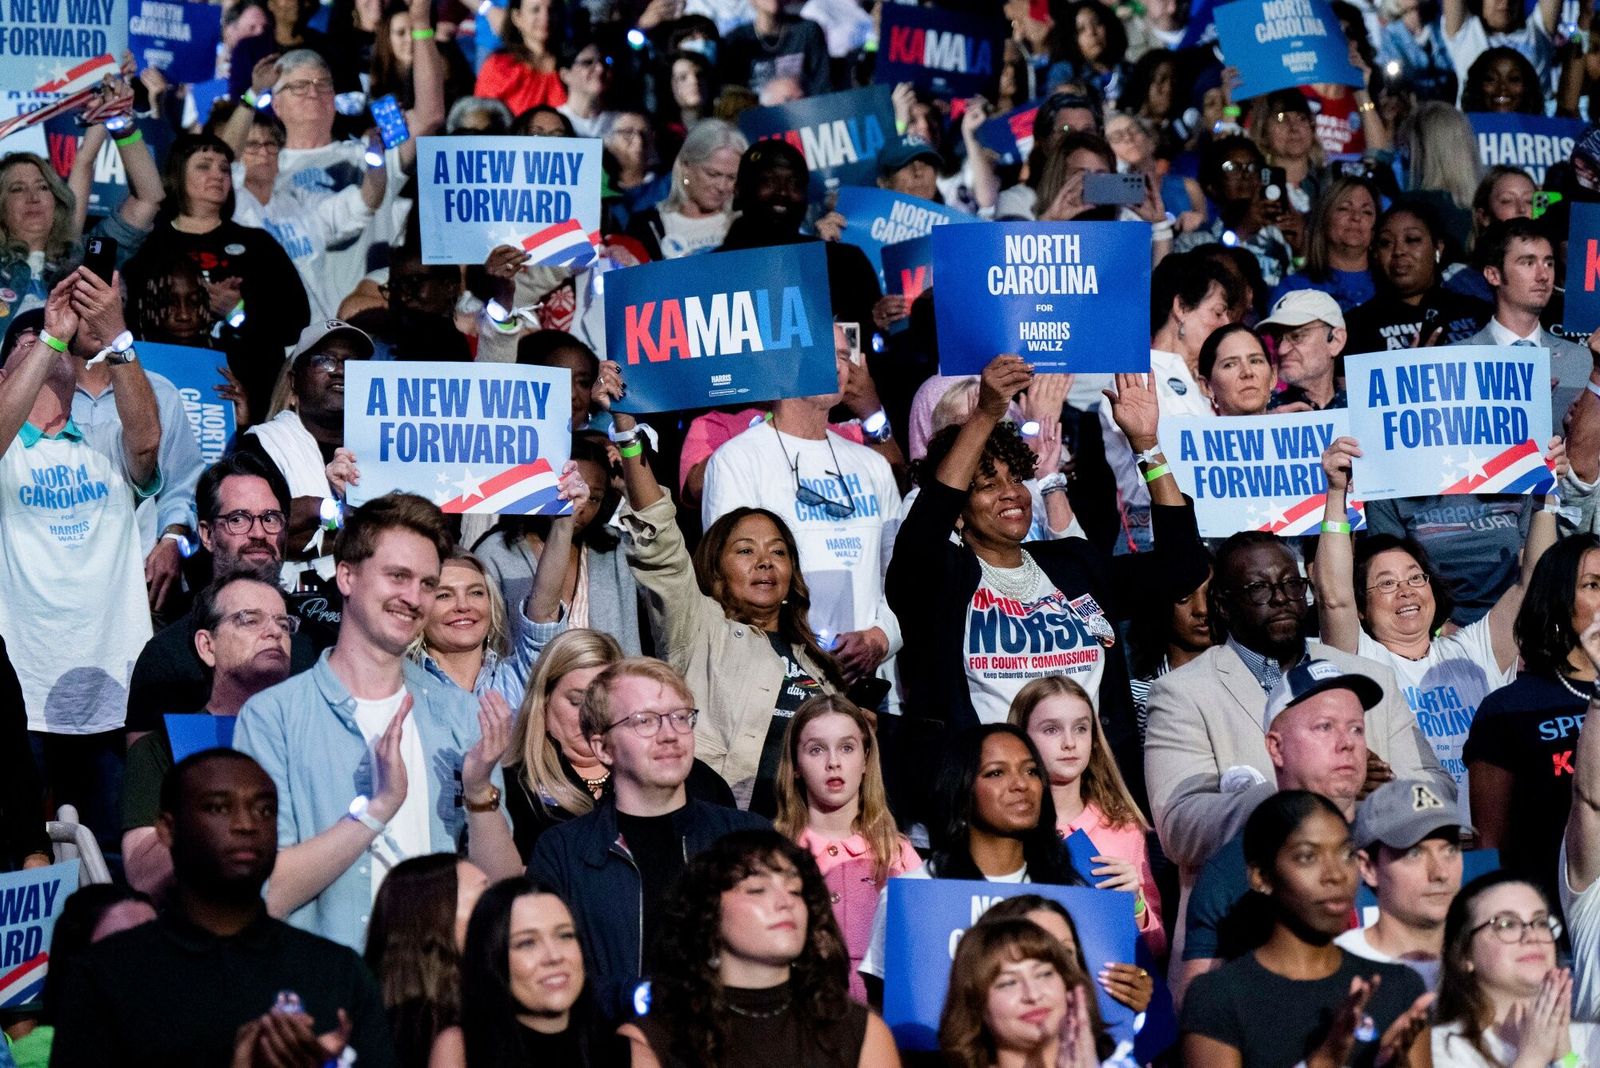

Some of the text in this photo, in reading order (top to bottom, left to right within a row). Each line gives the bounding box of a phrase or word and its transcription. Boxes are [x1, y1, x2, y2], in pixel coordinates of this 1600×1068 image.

[10, 0, 114, 25] NEW WAY
[1255, 16, 1328, 44] CAROLINA
[889, 25, 992, 75] KAMALA
[1477, 132, 1575, 167] HARRIS
[433, 150, 584, 186] A NEW WAY
[444, 188, 572, 224] FORWARD
[1004, 234, 1080, 264] NORTH
[987, 265, 1099, 296] CAROLINA
[1035, 304, 1053, 312] FOR
[625, 286, 814, 366] KAMALA
[1019, 321, 1071, 341] HARRIS
[1027, 340, 1063, 352] WALZ
[366, 377, 551, 420] A NEW WAY
[1368, 362, 1535, 408] A NEW WAY
[202, 403, 226, 464] NORTH
[379, 421, 540, 465] FORWARD
[1180, 423, 1334, 461] A NEW WAY
[1382, 406, 1529, 451] FORWARD
[30, 464, 89, 489] NORH
[1193, 462, 1328, 499] FORWARD
[19, 480, 109, 509] CAROLINA
[49, 520, 90, 536] HARRIS
[1469, 512, 1518, 532] WAL
[57, 533, 85, 542] WALZ
[825, 536, 862, 551] HARRIS
[834, 550, 858, 558] WALZ
[1075, 599, 1101, 618] NURSE
[969, 603, 1098, 654] NURSE
[969, 649, 1099, 671] FOR COUNTY COMMISSIONER
[1065, 667, 1077, 675] VOTE
[1078, 665, 1092, 673] NURSE
[787, 683, 806, 700] day
[1416, 705, 1478, 738] ROLIN
[0, 879, 61, 927] WAY
